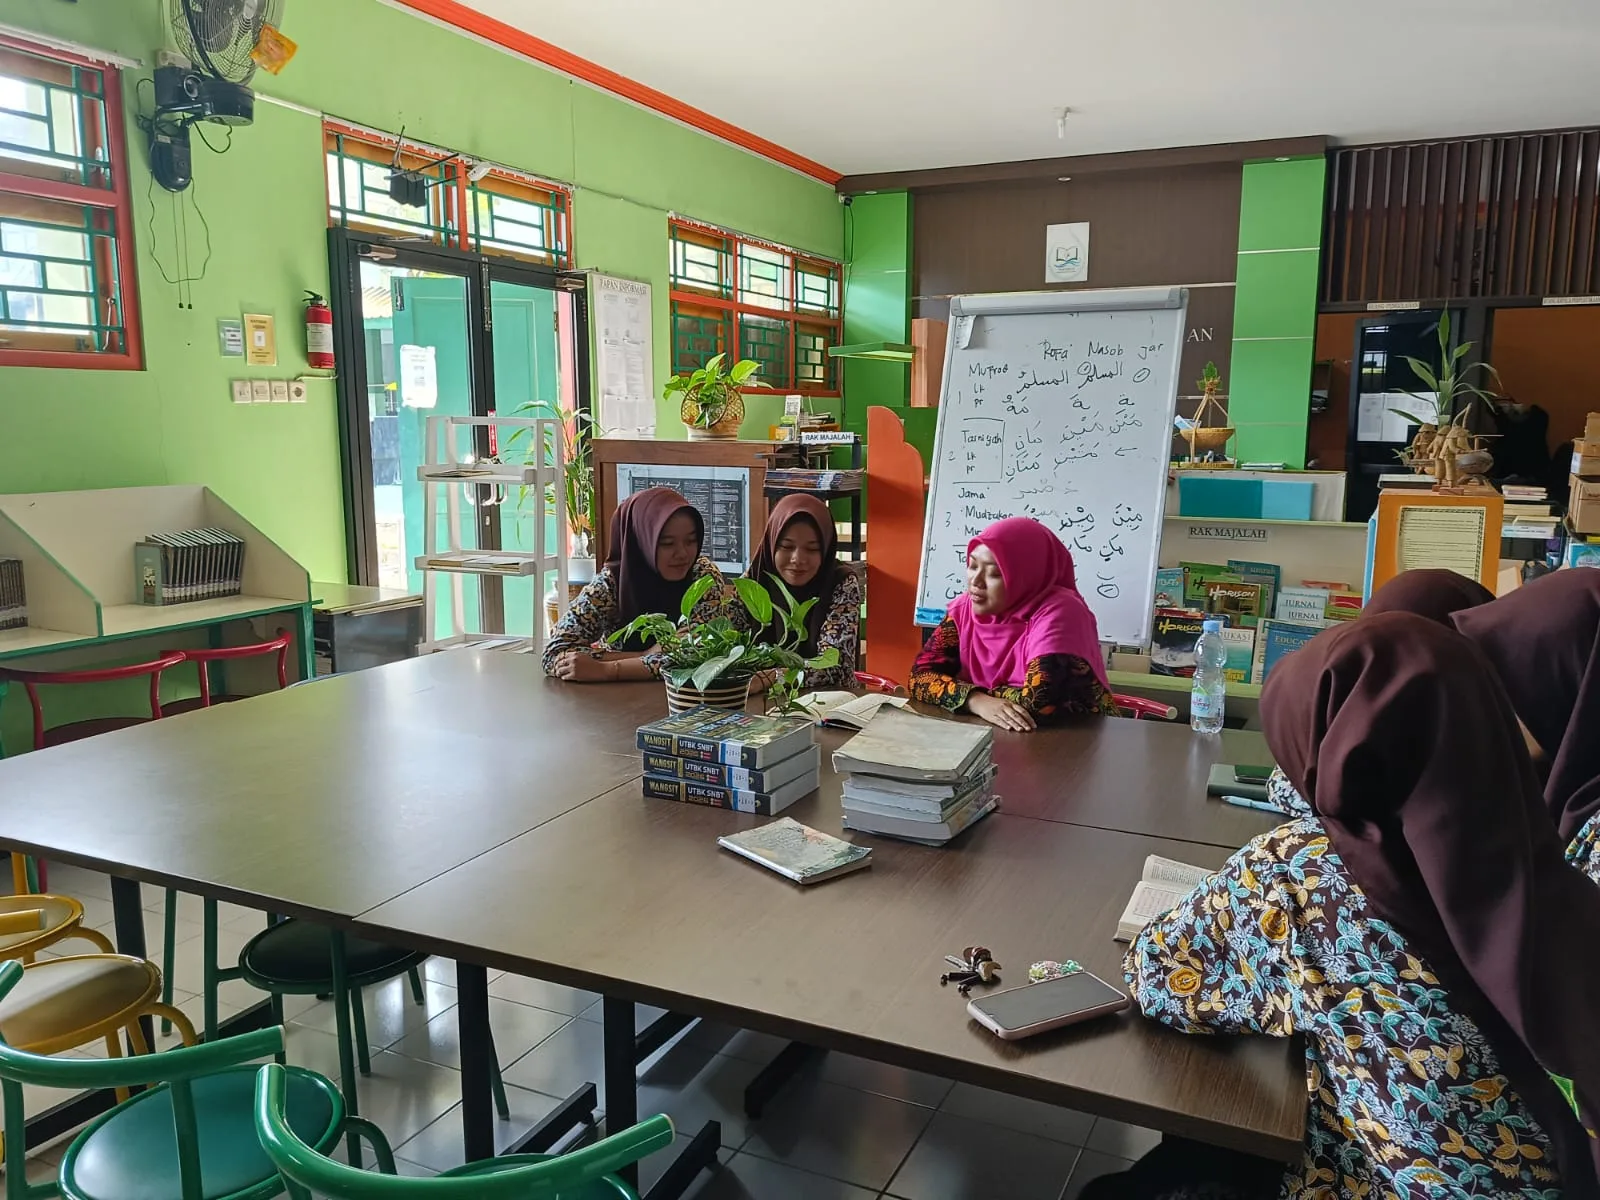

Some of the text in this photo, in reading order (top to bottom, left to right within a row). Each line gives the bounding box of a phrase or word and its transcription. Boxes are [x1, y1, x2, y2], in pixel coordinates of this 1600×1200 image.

[1187, 327, 1213, 342] AN
[1190, 527, 1266, 539] RAK MAJALAH
[1286, 599, 1317, 609] JURNAL
[679, 740, 697, 750] UTBK
[697, 743, 714, 752] SNBT
[685, 763, 702, 773] UTBK
[702, 766, 720, 776] SNBT
[687, 786, 705, 796] UTBK
[706, 789, 724, 799] SNBT
